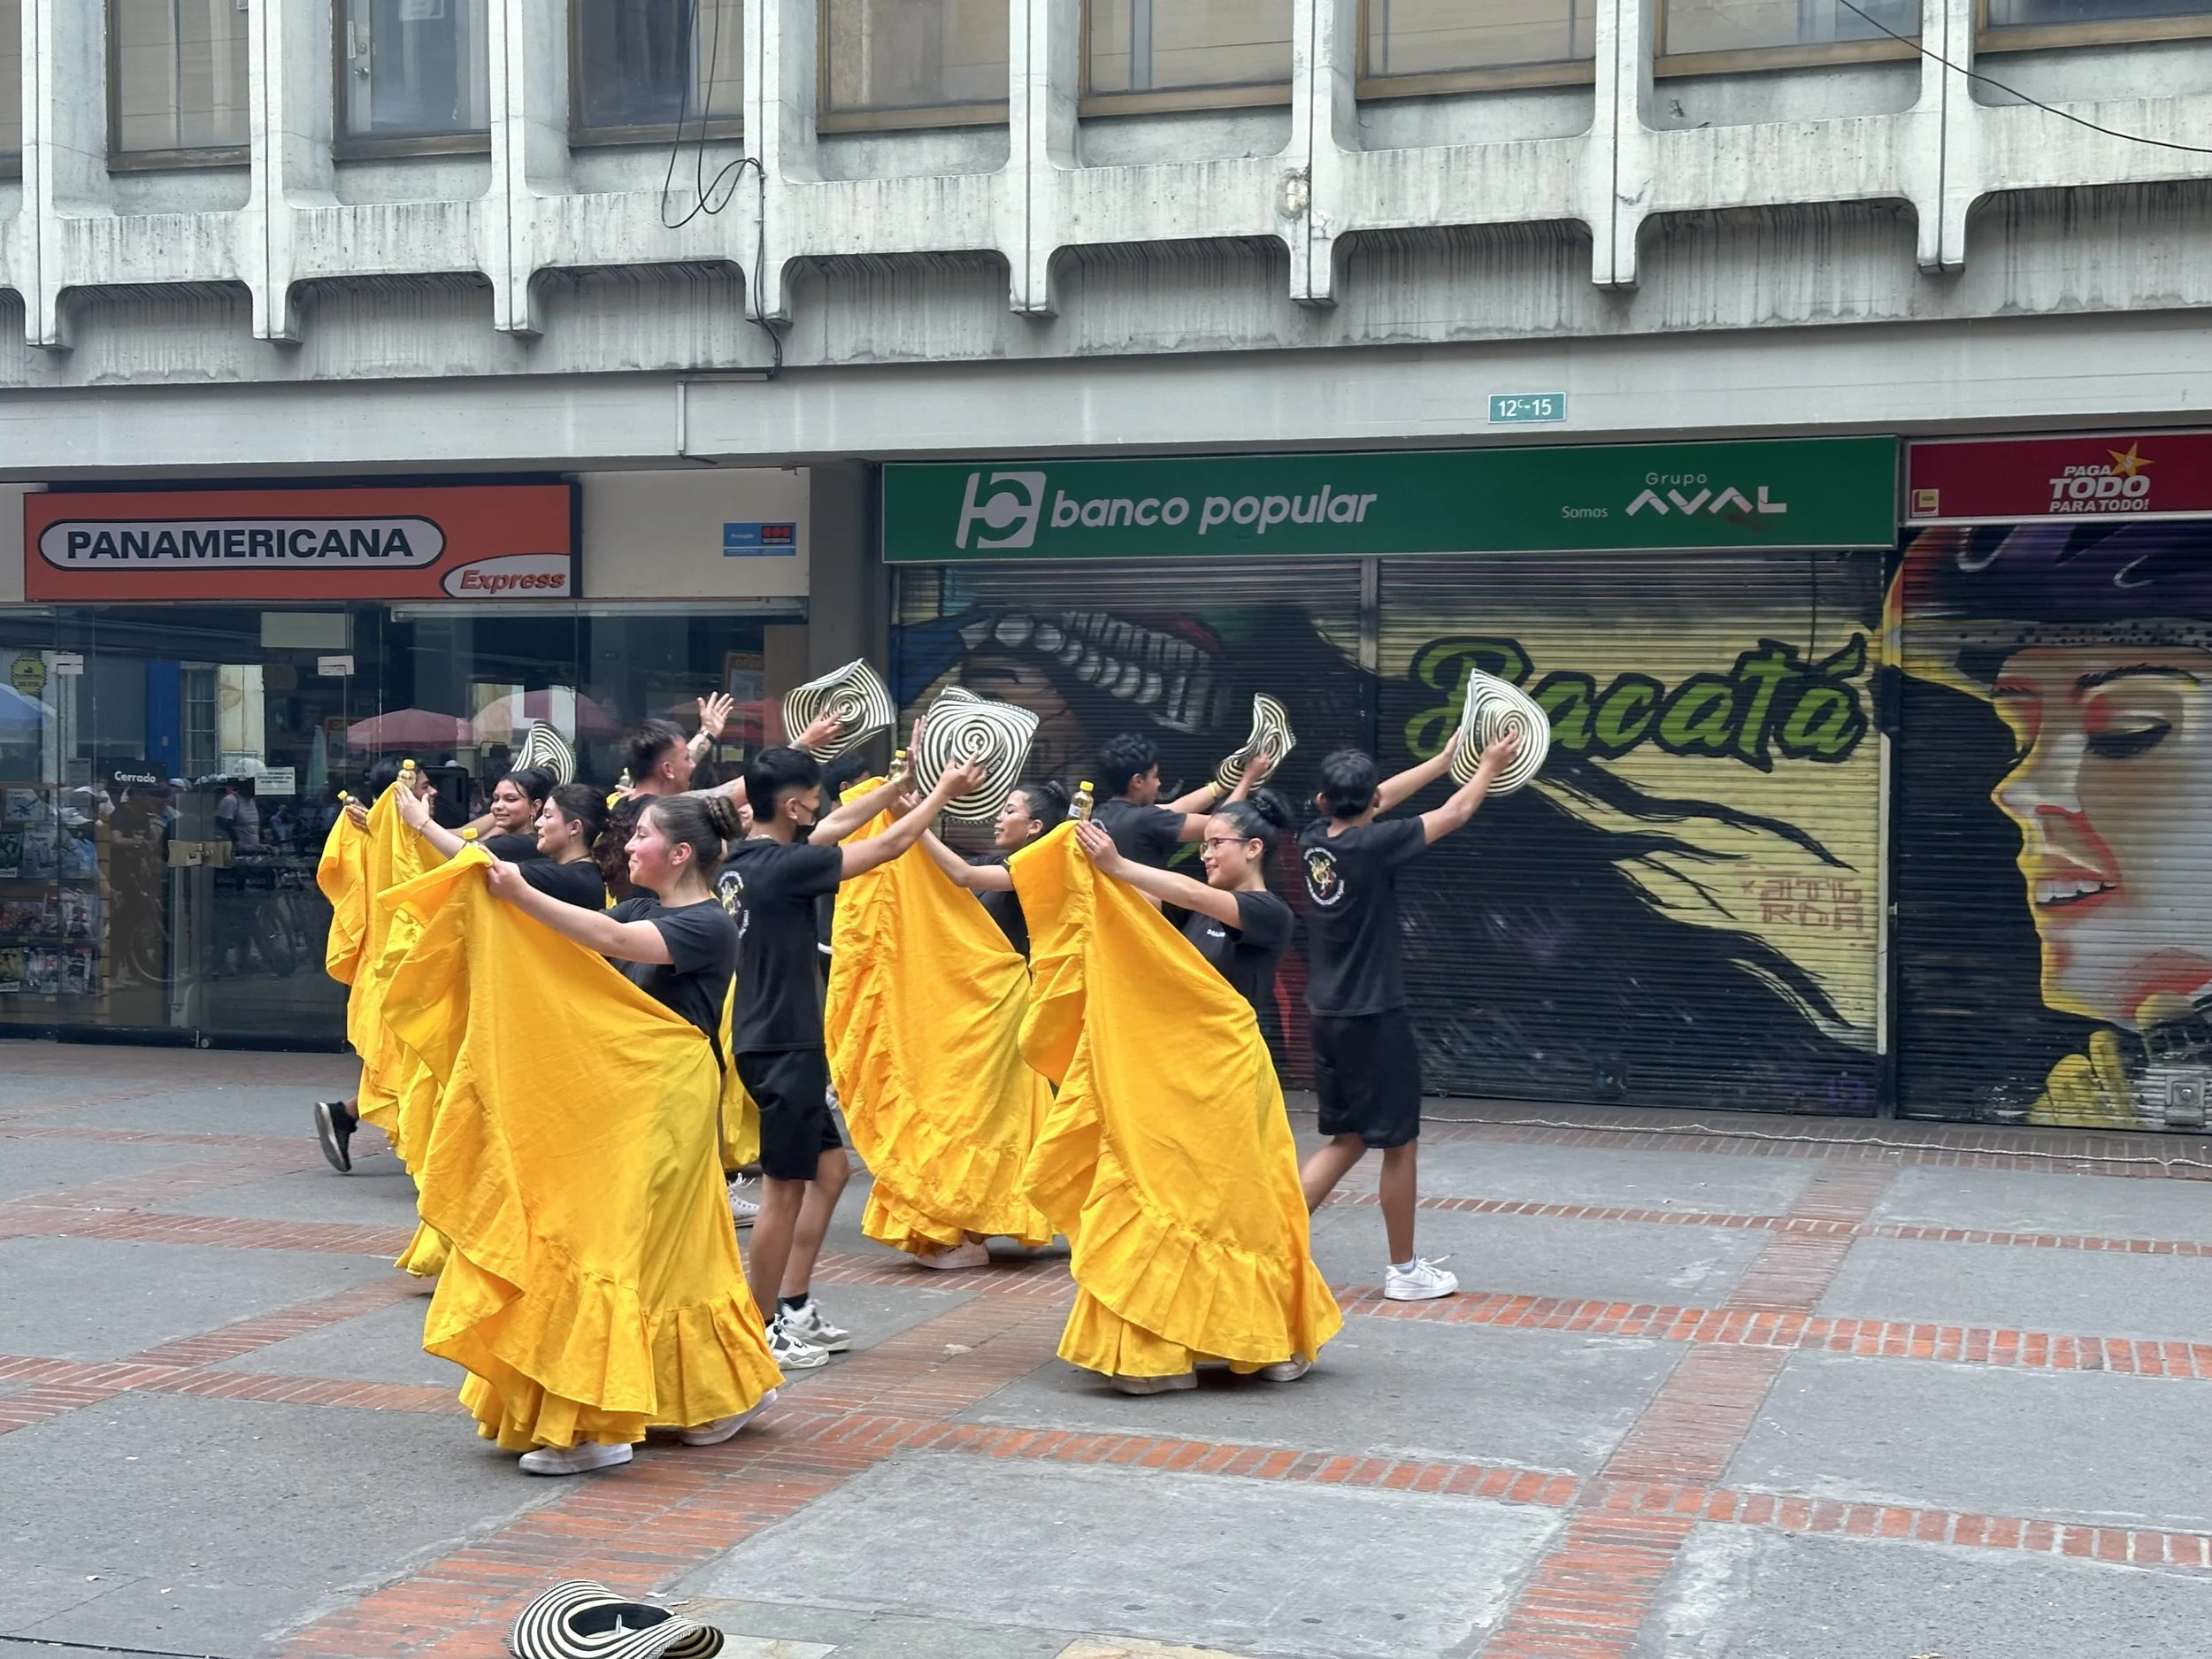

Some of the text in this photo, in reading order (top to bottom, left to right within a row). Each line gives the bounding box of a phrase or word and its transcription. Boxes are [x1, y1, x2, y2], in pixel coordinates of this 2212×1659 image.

[1645, 472, 1708, 487] Grupo
[2063, 465, 2112, 476] PAGA
[2049, 474, 2150, 499] TODO
[1051, 484, 1378, 534] banco popular
[1625, 486, 1787, 516] AVAL
[2048, 498, 2150, 513] PARA TODO!
[1562, 505, 1609, 518] Somos
[66, 528, 413, 559] PANAMERICANA
[460, 569, 565, 591] Express
[114, 771, 157, 783] Cerrado
